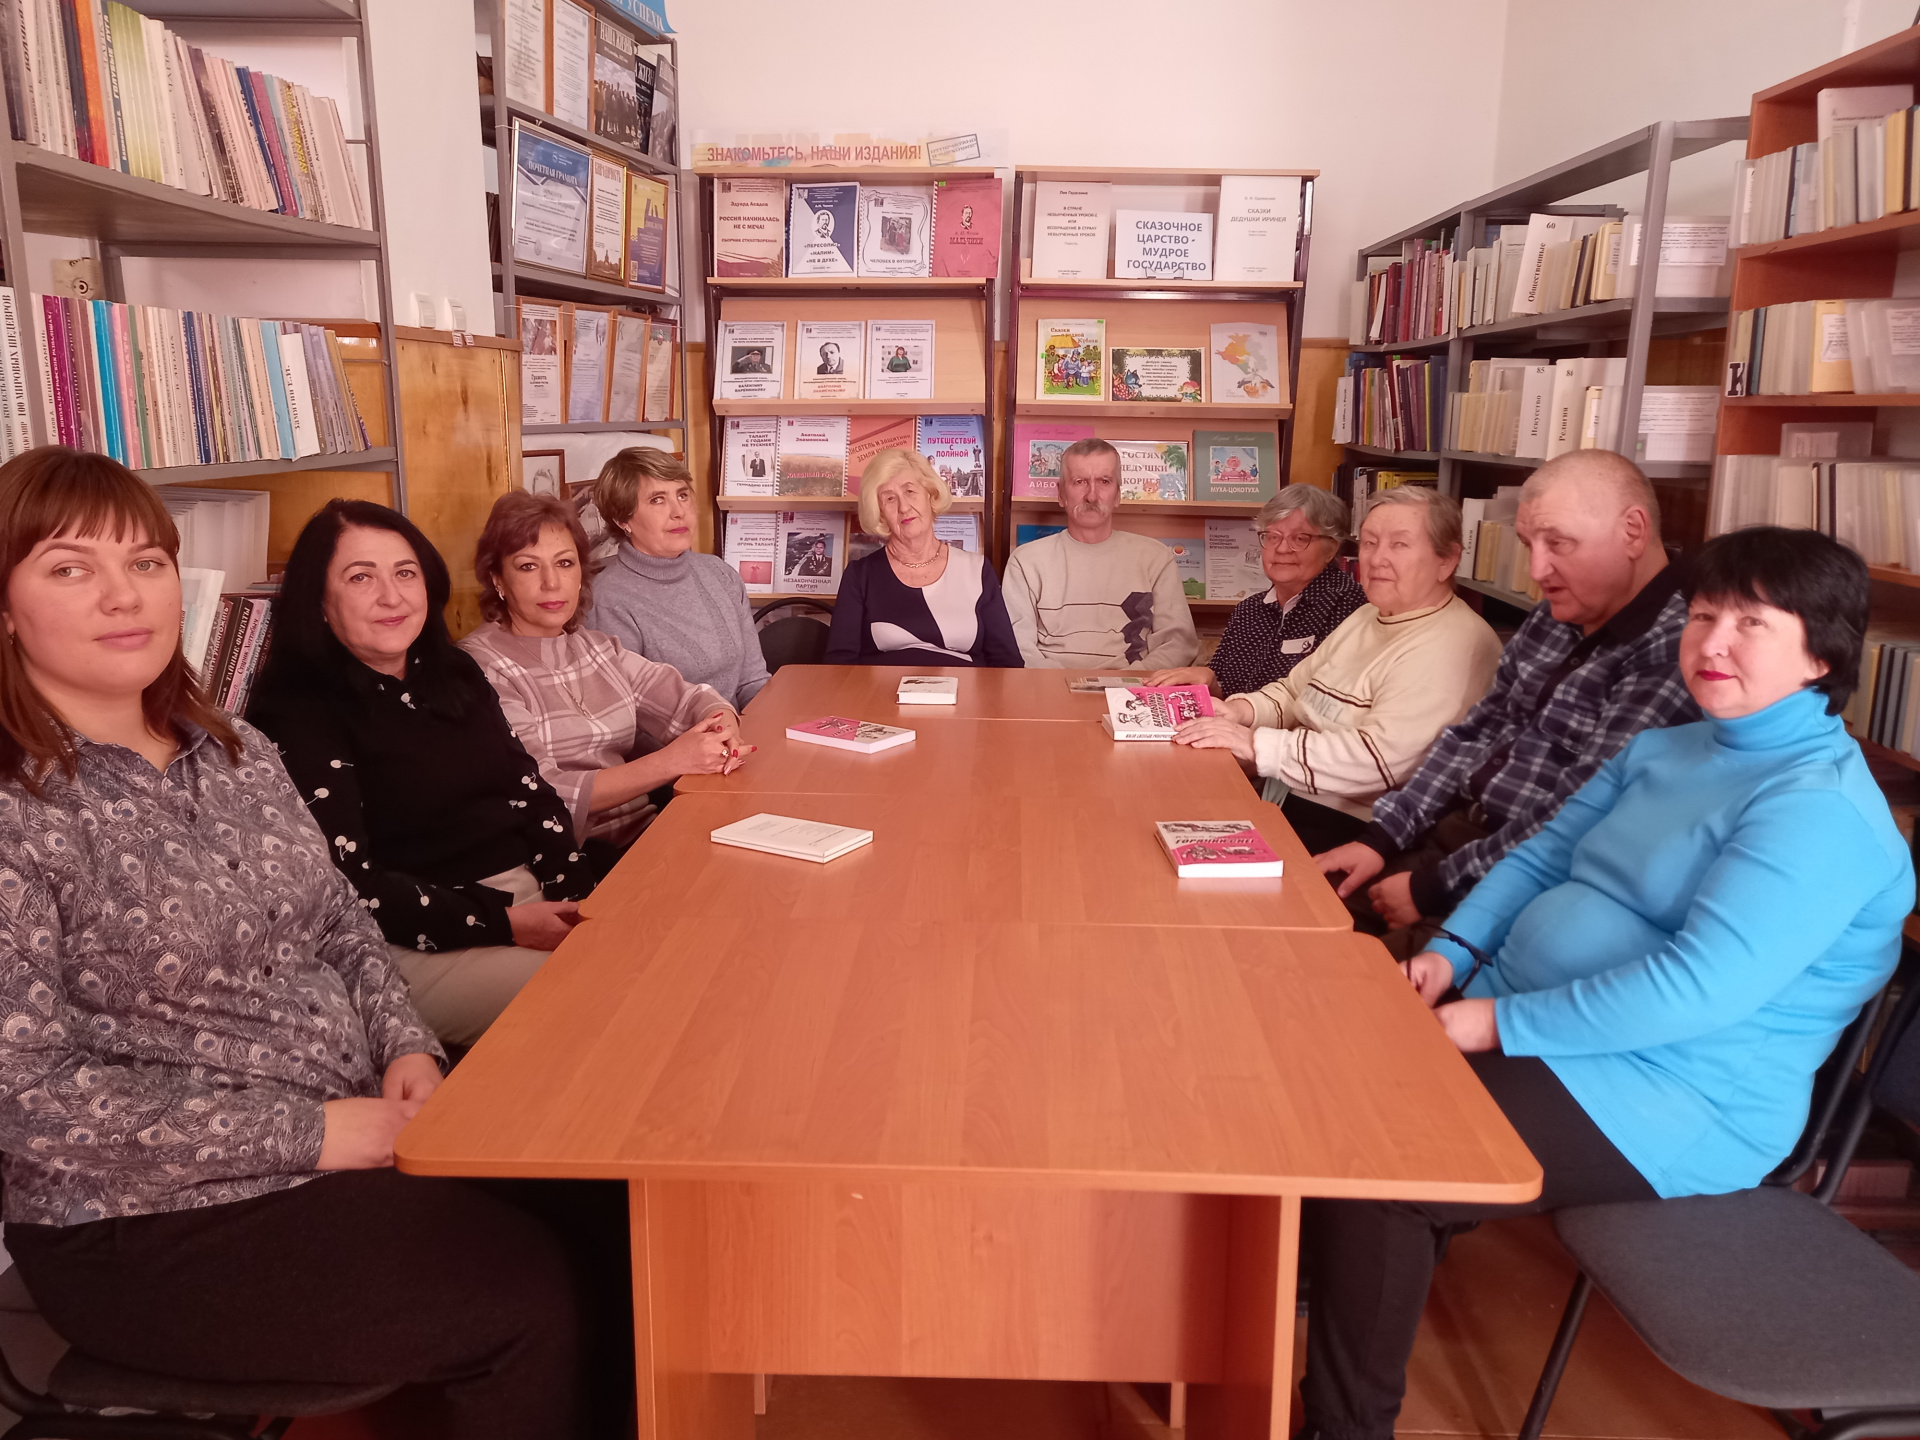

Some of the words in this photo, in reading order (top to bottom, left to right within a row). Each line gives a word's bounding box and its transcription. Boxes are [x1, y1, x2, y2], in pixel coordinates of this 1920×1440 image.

[103, 14, 113, 44] ЛУГА
[106, 47, 120, 99] ГОЛУБЫЕ
[707, 146, 807, 163] ЗНАКОМЬТЕСЬ,
[811, 145, 851, 160] НАШИ
[855, 145, 922, 162] ИЗДАНИЯ!
[529, 161, 556, 177] ПОЧЕТНАЯ
[1135, 220, 1203, 232] СКАЗОЧНОЕ
[1137, 234, 1189, 245] ЦАРСТВО
[1142, 247, 1189, 258] МУДРОЕ
[1127, 260, 1207, 271] ГОСУДАРСТВО
[1527, 242, 1546, 303] Общественные
[2, 294, 18, 350] ШЕДЕВРОВ
[9, 351, 24, 404] МИРОВЫХ
[45, 370, 53, 404] ВЕЩИЙ
[1727, 362, 1747, 396] К
[17, 403, 27, 417] 100
[1531, 395, 1542, 436] Искусство
[1558, 407, 1569, 441] Религия
[927, 437, 976, 445] ПУТЕШЕСТВУЙ
[857, 450, 876, 463] ЗЕМЛИ
[1121, 451, 1160, 459] ГОСТЯХ
[226, 644, 240, 682] ТАЙНЫЕ
[235, 606, 250, 645] ФРЕГАТЫ
[237, 651, 249, 675] Старик
